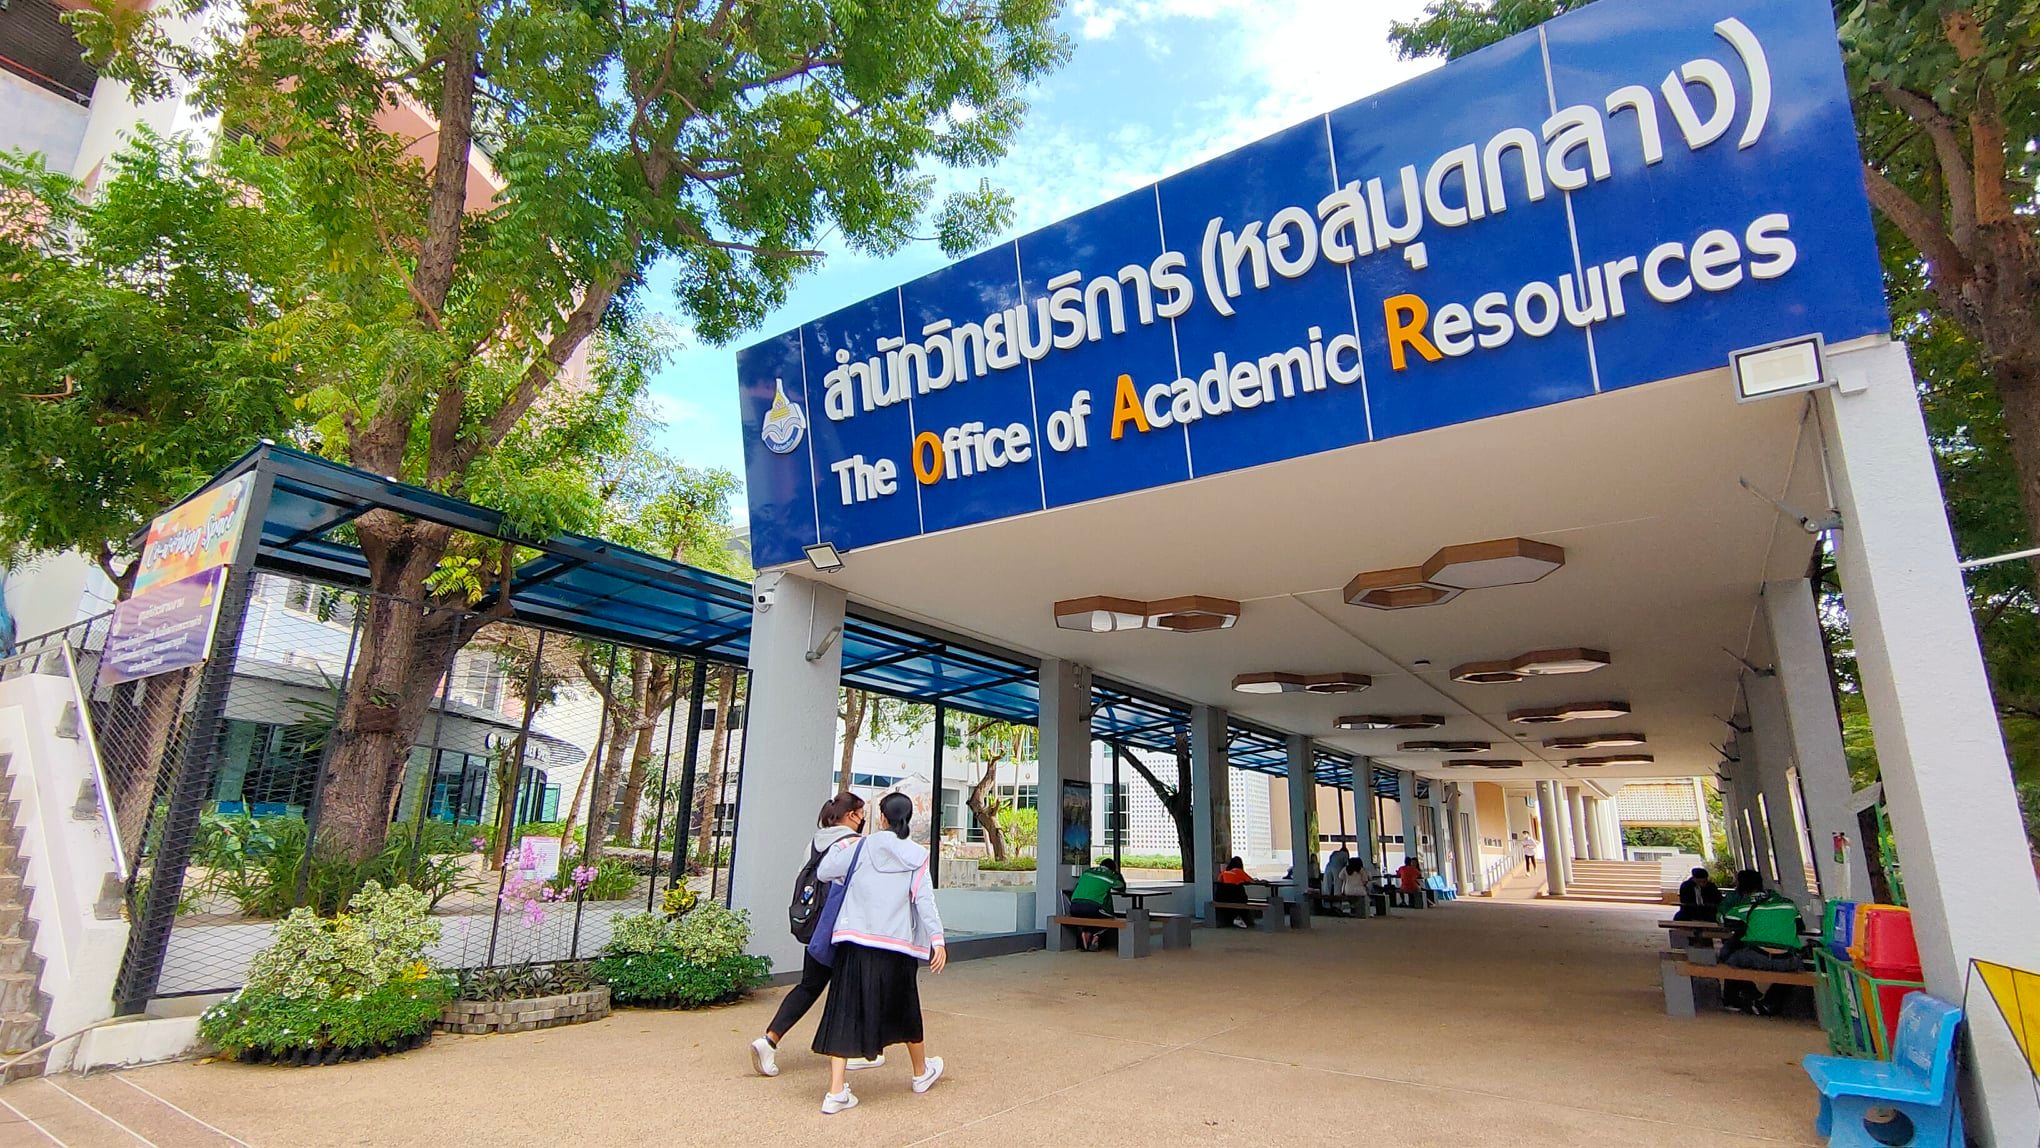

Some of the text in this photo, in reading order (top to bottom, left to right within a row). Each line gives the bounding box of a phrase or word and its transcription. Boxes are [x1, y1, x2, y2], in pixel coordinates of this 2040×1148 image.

[824, 16, 1772, 422] สำนักวิทยบริการ (หอสมุดกลาง)
[831, 212, 1797, 505] The Office of Academic Resources
